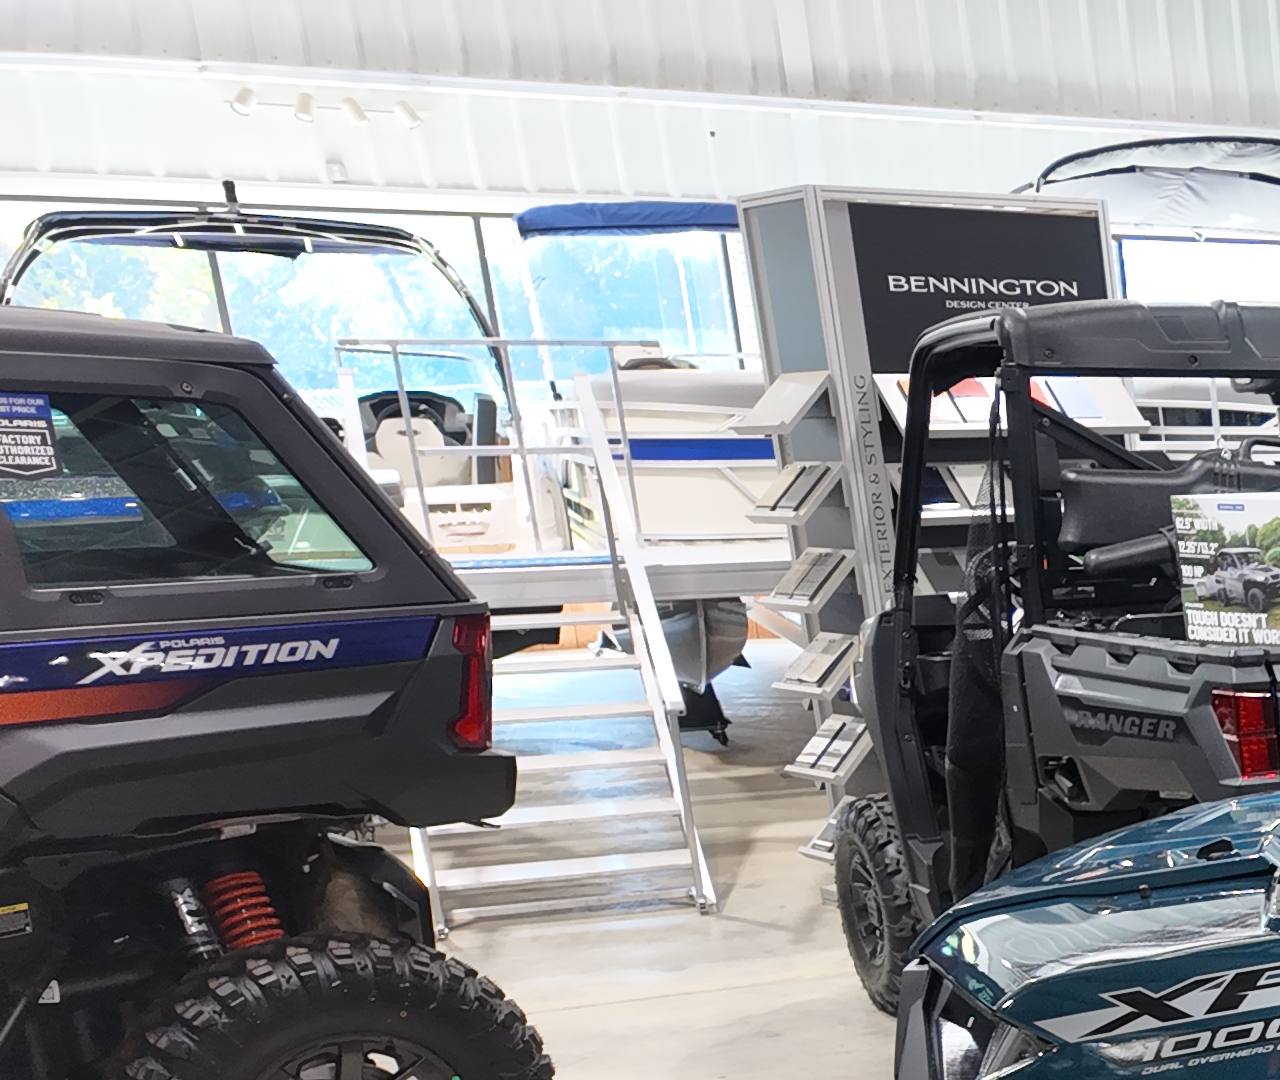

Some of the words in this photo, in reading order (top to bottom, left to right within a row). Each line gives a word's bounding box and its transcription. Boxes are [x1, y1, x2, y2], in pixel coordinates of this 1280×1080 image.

[887, 275, 1079, 297] BENNINGTON
[945, 300, 985, 309] DESIGN
[854, 374, 878, 465] STYLING
[858, 472, 880, 486] &
[1186, 610, 1218, 626] TOUGH
[1220, 613, 1268, 629] DOESN'T
[159, 637, 226, 649] POLARIS
[1188, 625, 1237, 642] CONSIDER
[1238, 628, 1249, 644] IT
[76, 638, 340, 685] XPEDITION
[1075, 710, 1177, 739] RANGER
[1141, 1062, 1184, 1075] DUAL
[1187, 1045, 1275, 1067] OVERHEAD
